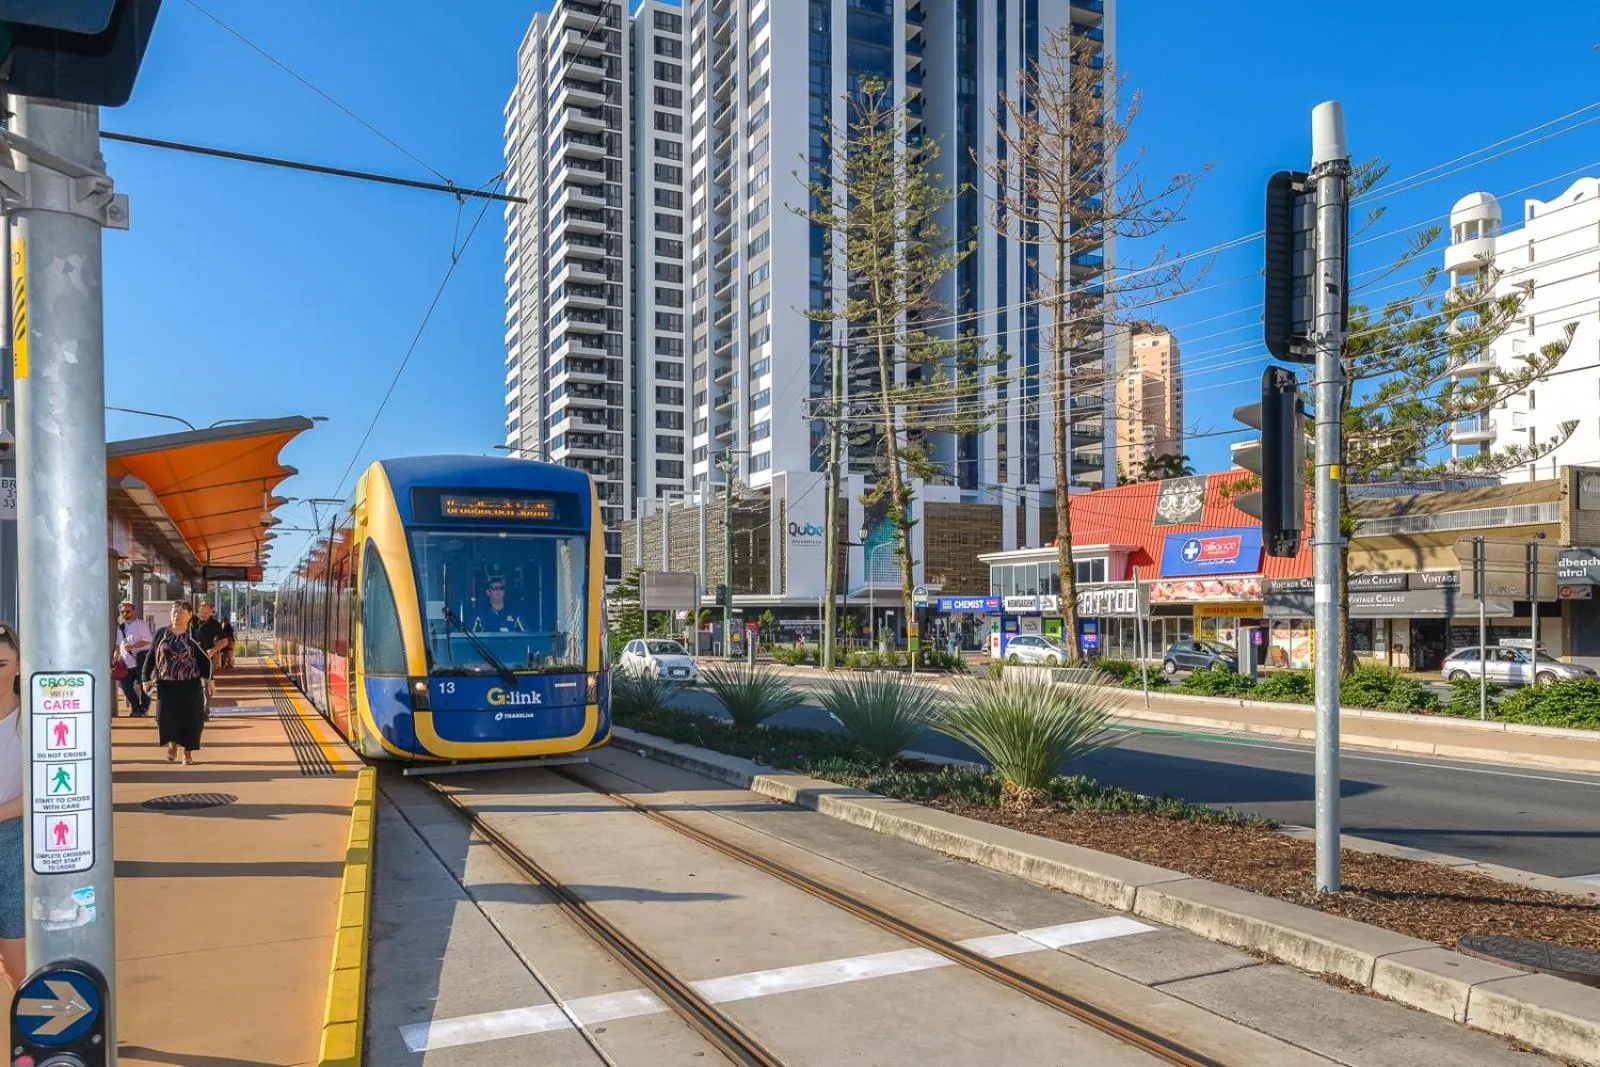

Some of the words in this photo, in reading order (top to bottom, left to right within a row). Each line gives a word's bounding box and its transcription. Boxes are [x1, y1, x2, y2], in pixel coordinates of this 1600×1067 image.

[788, 522, 824, 537] Qube
[954, 599, 985, 609] CHEMIST
[39, 677, 85, 688] CROSS
[438, 682, 455, 694] 13
[43, 699, 80, 710] CARE
